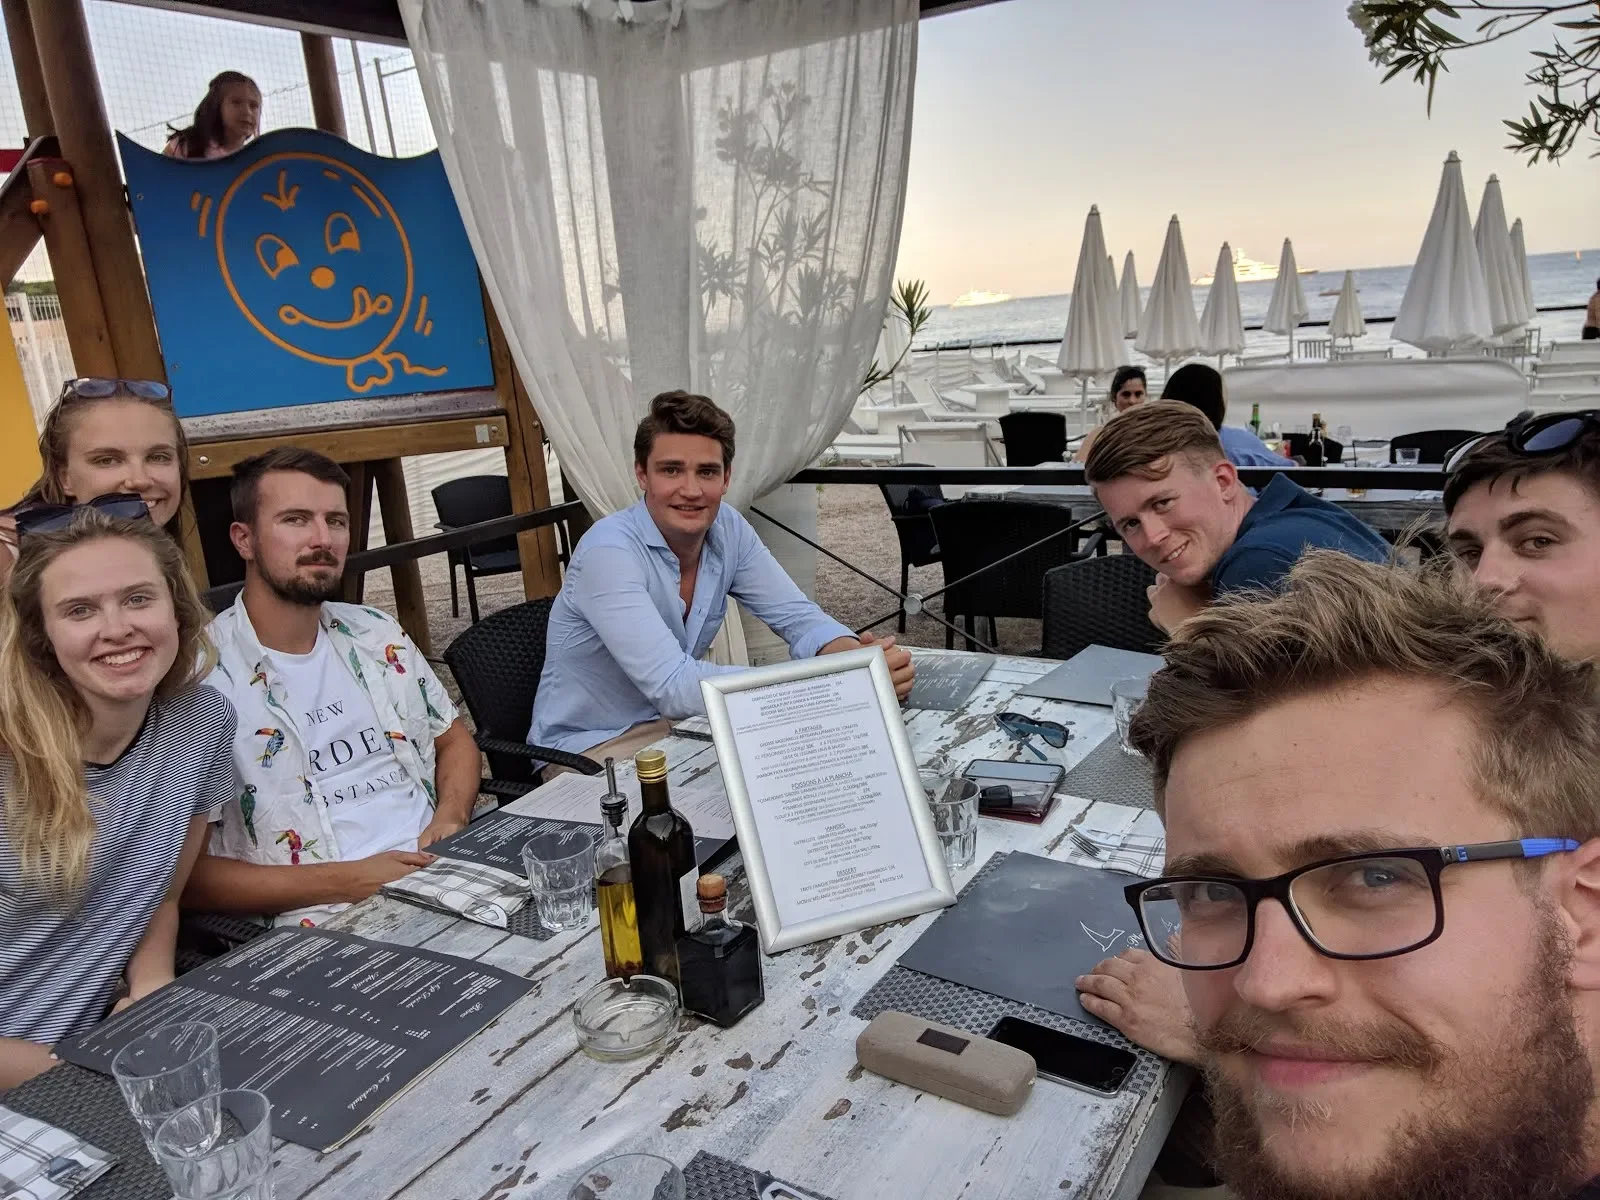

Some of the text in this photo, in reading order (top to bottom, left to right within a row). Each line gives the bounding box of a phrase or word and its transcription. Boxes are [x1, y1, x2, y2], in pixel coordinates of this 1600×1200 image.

[304, 699, 345, 727] NEW
[309, 727, 386, 776] RDE
[836, 866, 857, 876] DESSERT
